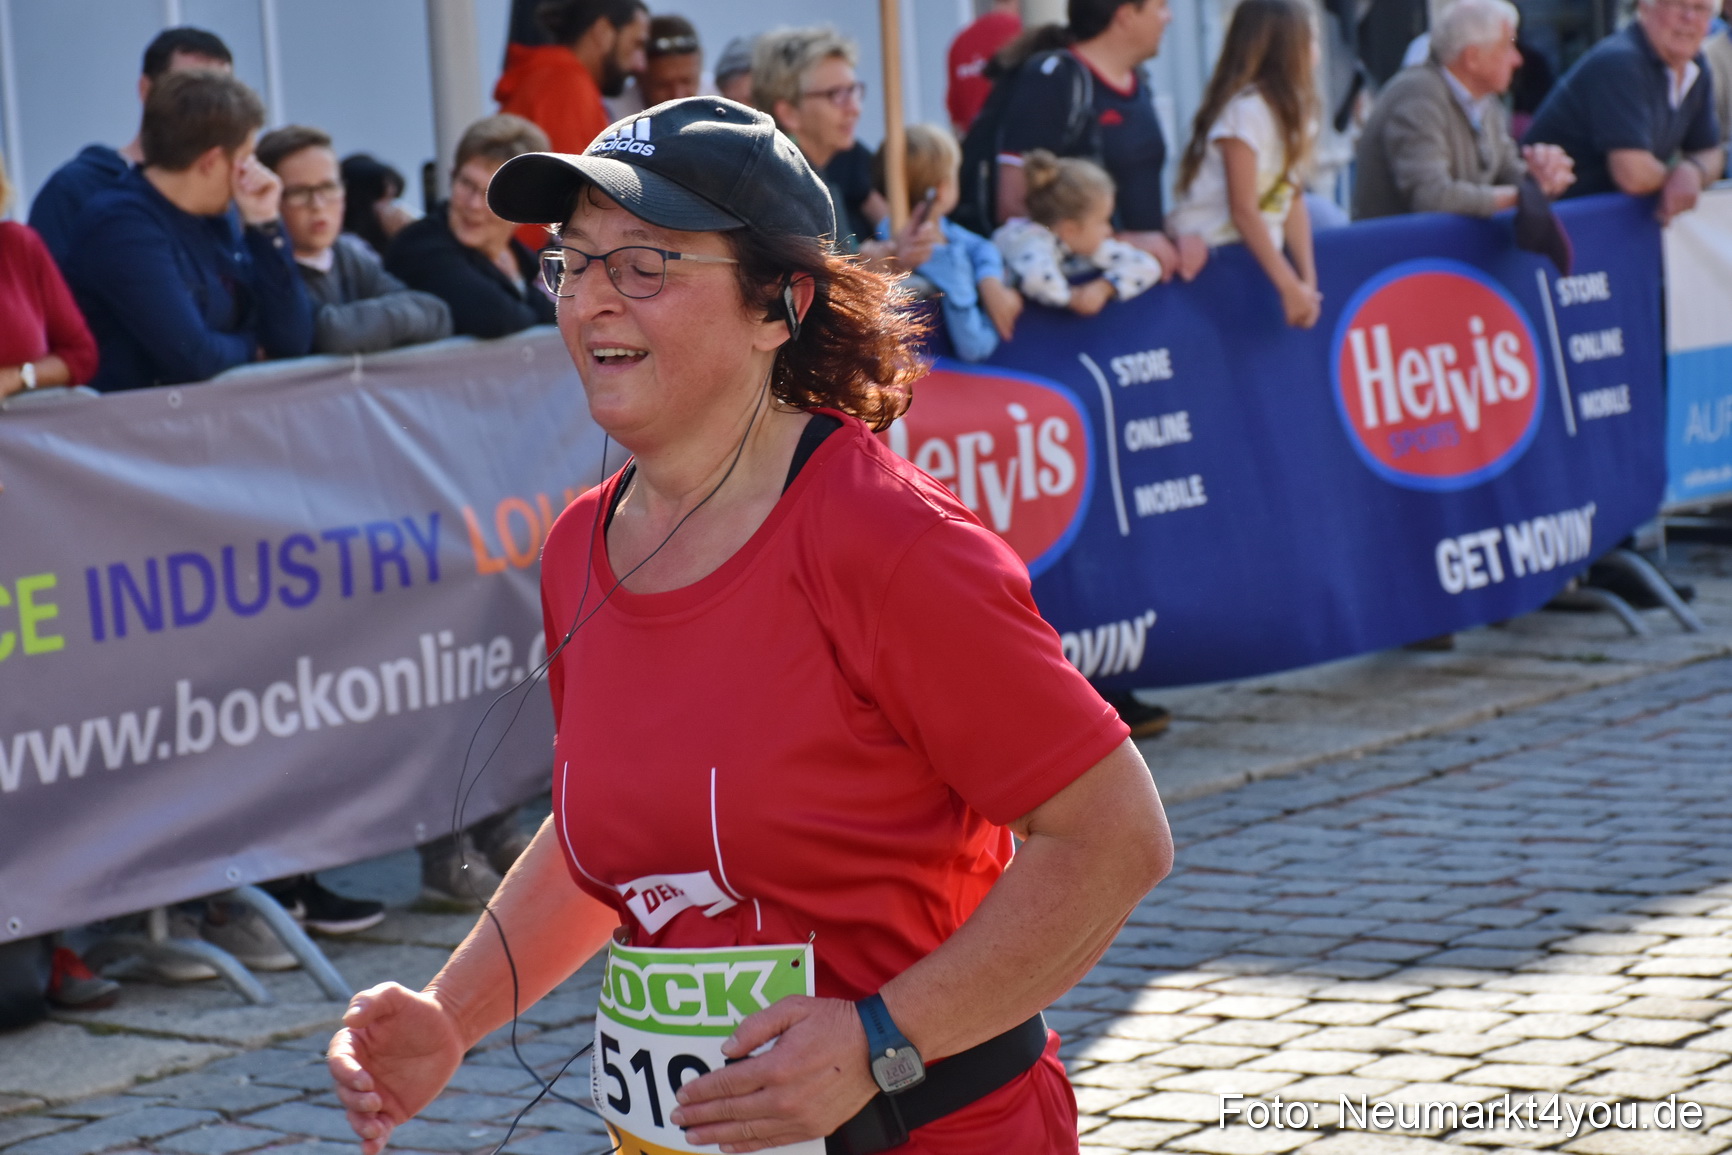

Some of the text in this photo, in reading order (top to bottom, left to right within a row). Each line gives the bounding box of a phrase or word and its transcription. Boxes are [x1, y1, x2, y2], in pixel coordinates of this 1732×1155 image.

[591, 137, 656, 157] adidas
[1555, 271, 1611, 307] STORE
[1568, 327, 1625, 363] ONLINE
[1110, 347, 1174, 387] STORE
[1350, 315, 1531, 433] Hervis
[1124, 410, 1193, 452] ONLINE
[1133, 473, 1208, 518] MOBILE
[85, 511, 440, 642] INDUSTRY
[1435, 526, 1505, 595] GET
